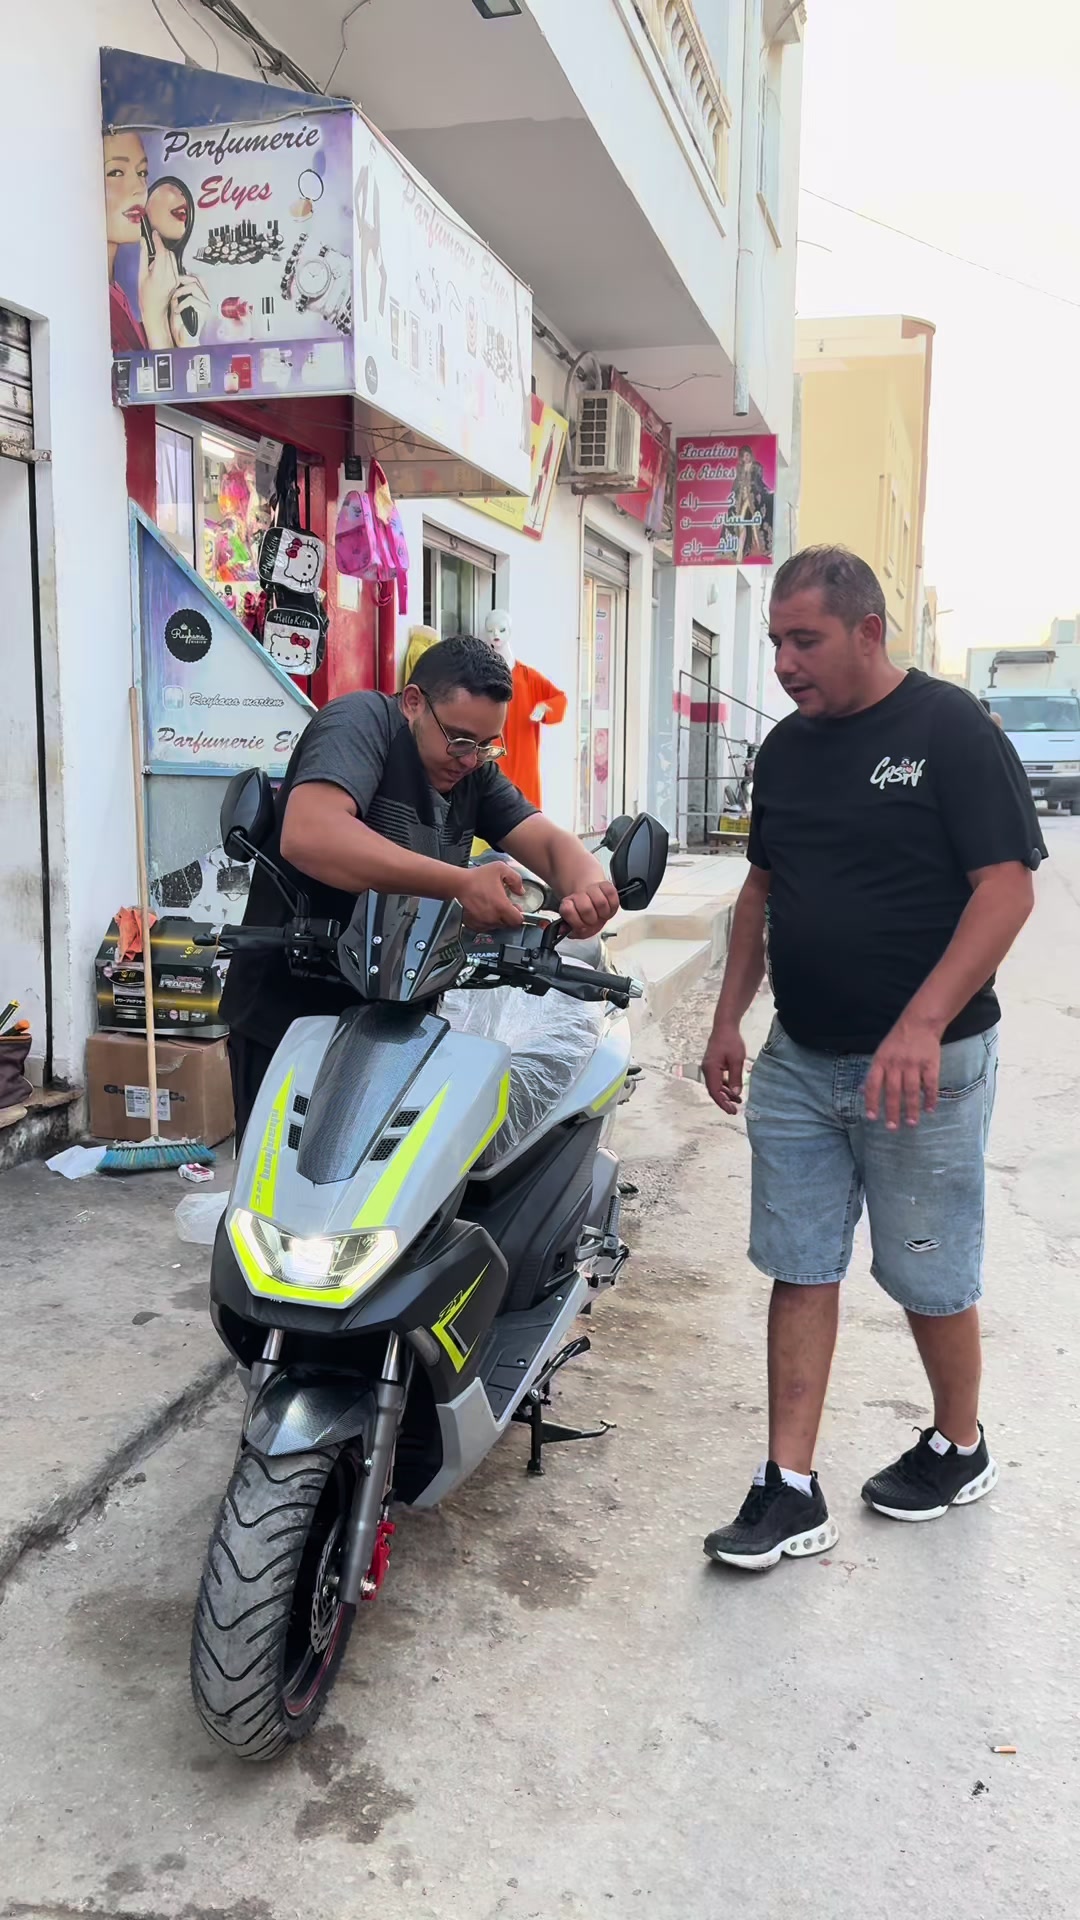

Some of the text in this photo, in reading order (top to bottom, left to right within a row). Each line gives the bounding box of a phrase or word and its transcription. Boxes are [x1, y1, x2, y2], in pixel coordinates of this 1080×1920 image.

[163, 125, 320, 165] Parfumerie
[197, 175, 272, 214] Elyes
[679, 442, 738, 460] Location
[678, 462, 737, 481] de Robes
[261, 535, 280, 574] Hello Kitty
[273, 612, 311, 628] Hello Kitty
[189, 692, 285, 709] Rayhana mariem
[157, 726, 298, 755] Parfumerie El
